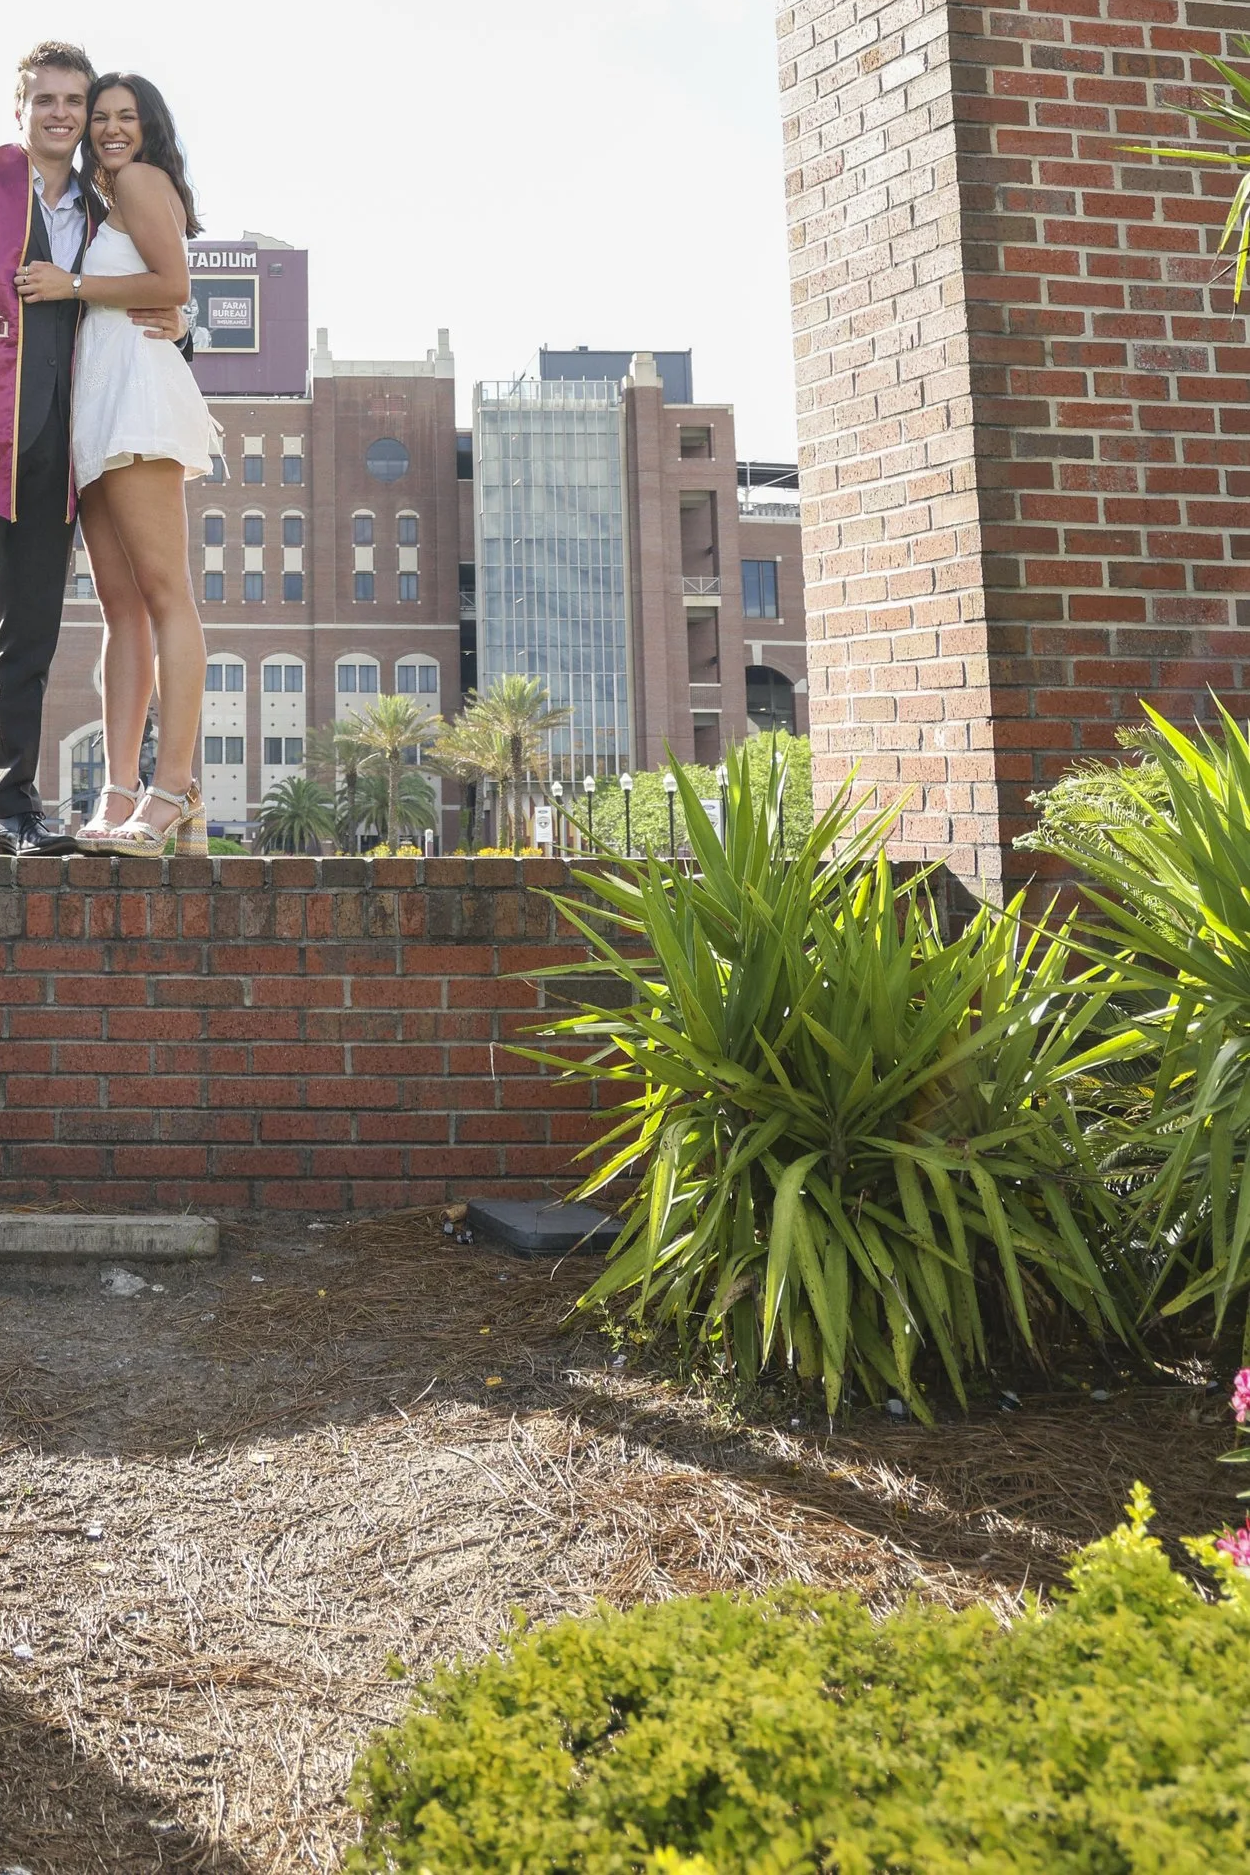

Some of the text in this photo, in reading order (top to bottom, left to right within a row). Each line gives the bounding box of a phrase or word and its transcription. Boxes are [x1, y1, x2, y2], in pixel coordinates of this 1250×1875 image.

[188, 252, 257, 267] TADIUM
[222, 301, 247, 309] FARM
[212, 309, 247, 318] BUREAU
